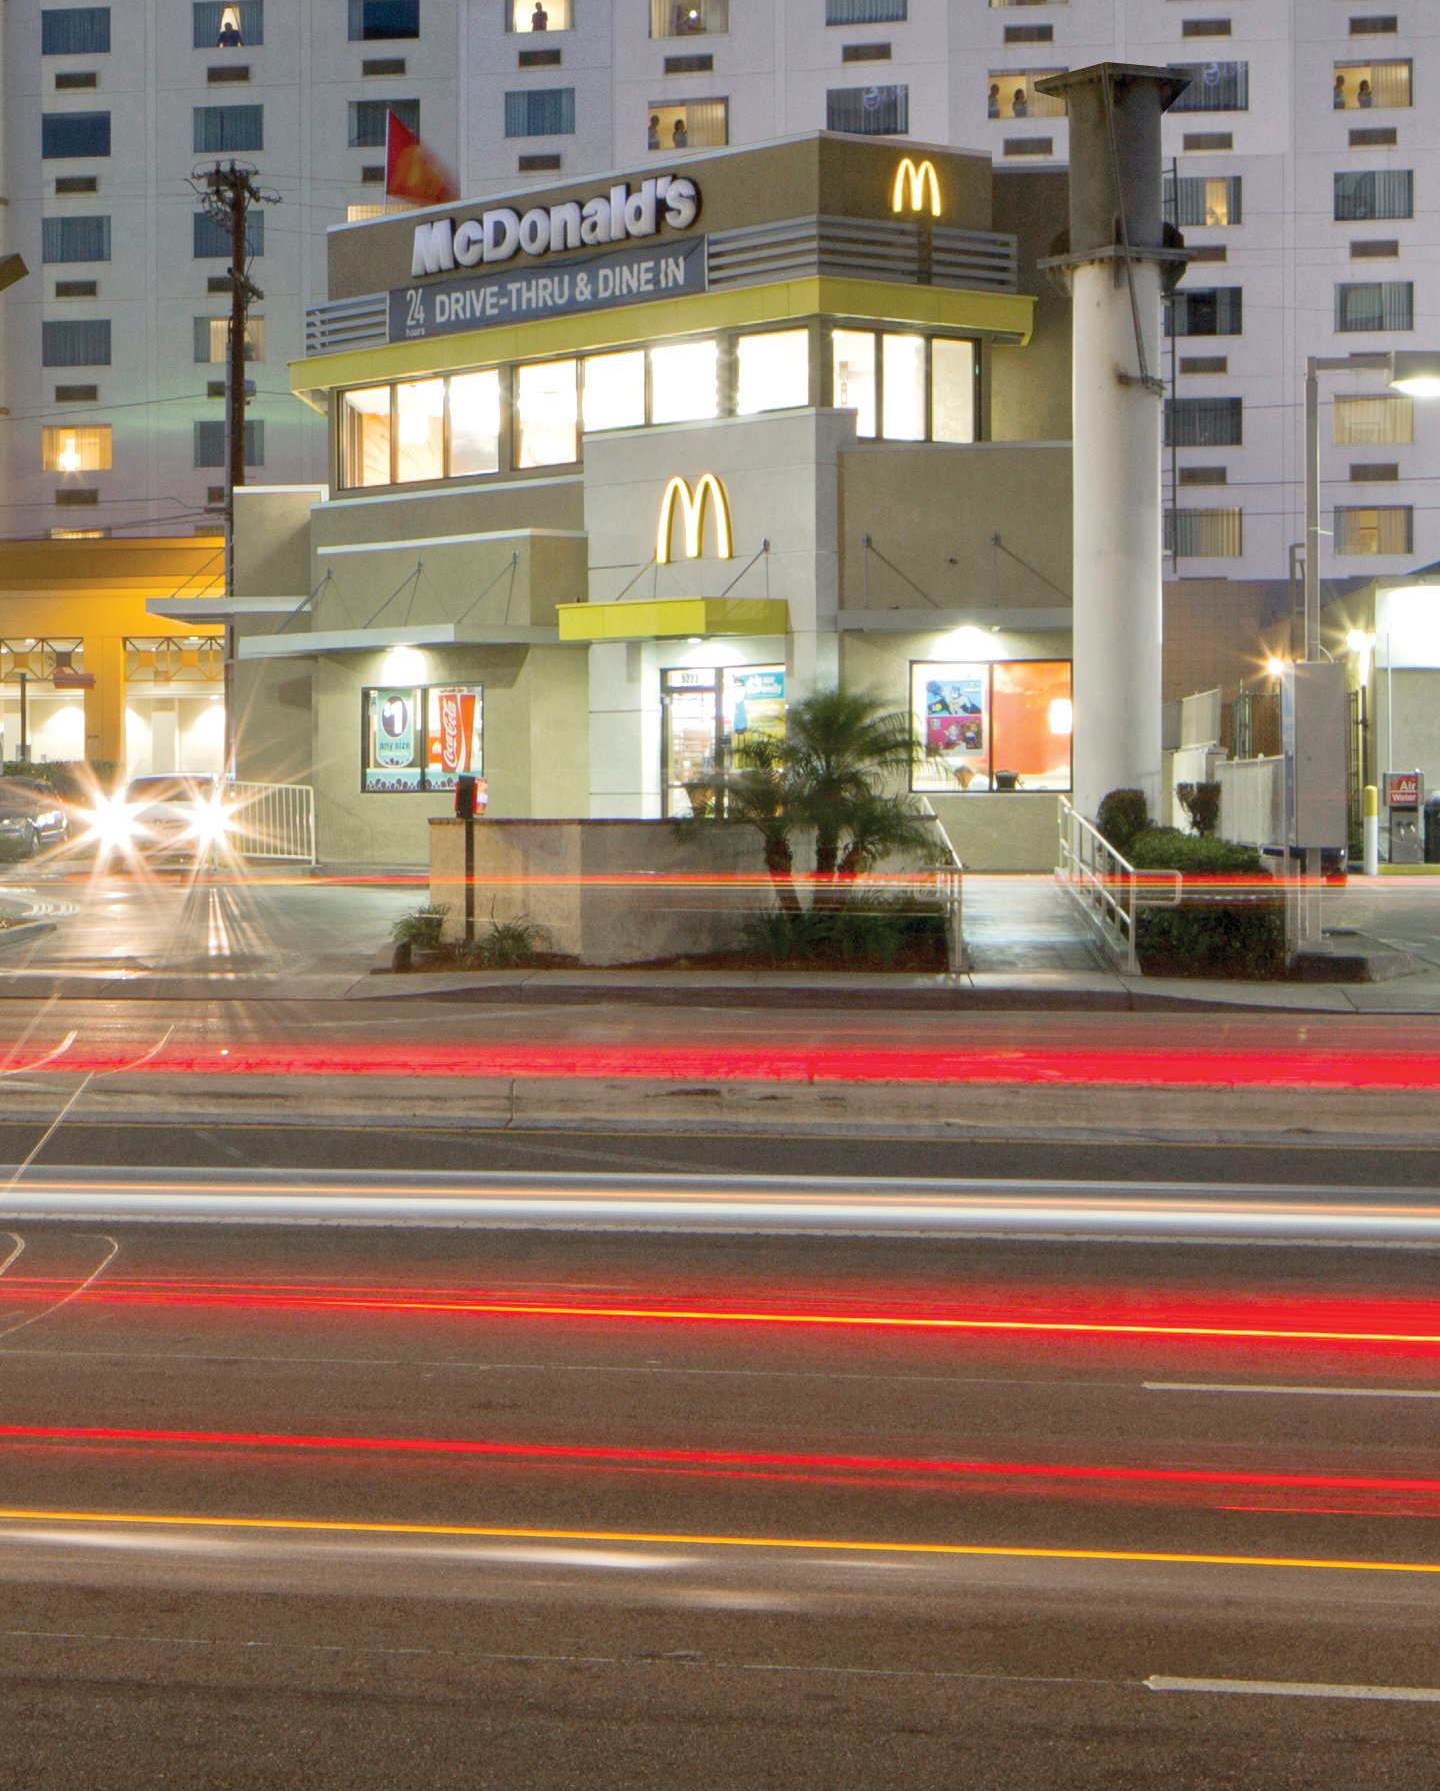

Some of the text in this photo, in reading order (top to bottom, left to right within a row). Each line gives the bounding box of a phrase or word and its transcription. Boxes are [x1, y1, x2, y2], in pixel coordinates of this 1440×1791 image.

[410, 175, 697, 277] McDonald's
[406, 255, 685, 326] 24 DRIVE-THRU & DINE IN
[442, 696, 459, 768] Coca-Cola
[1400, 779, 1417, 792] Air
